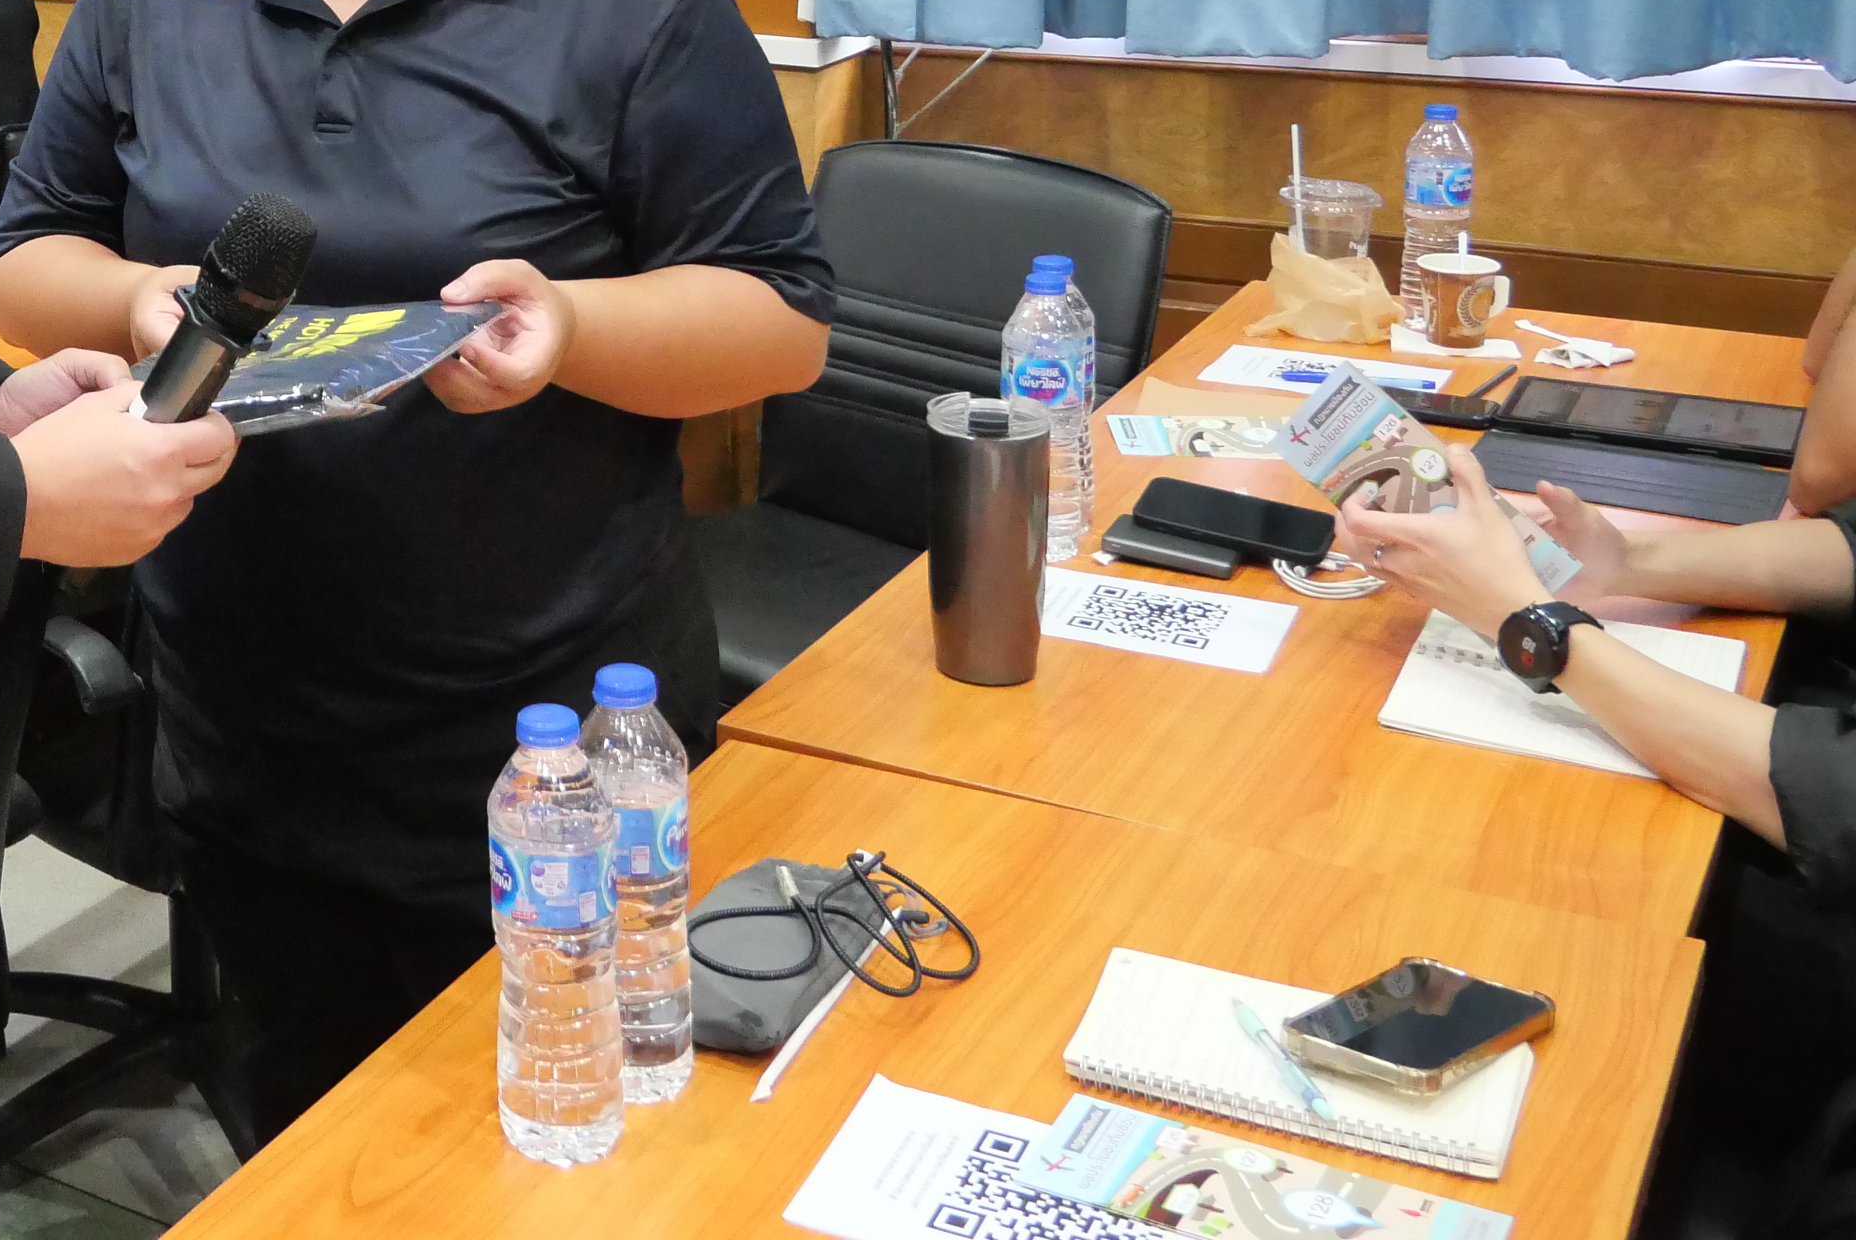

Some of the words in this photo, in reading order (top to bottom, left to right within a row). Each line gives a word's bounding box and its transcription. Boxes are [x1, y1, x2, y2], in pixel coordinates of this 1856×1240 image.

[1378, 418, 1398, 438] 126
[1419, 454, 1440, 476] 127
[1307, 1194, 1335, 1221] 128
